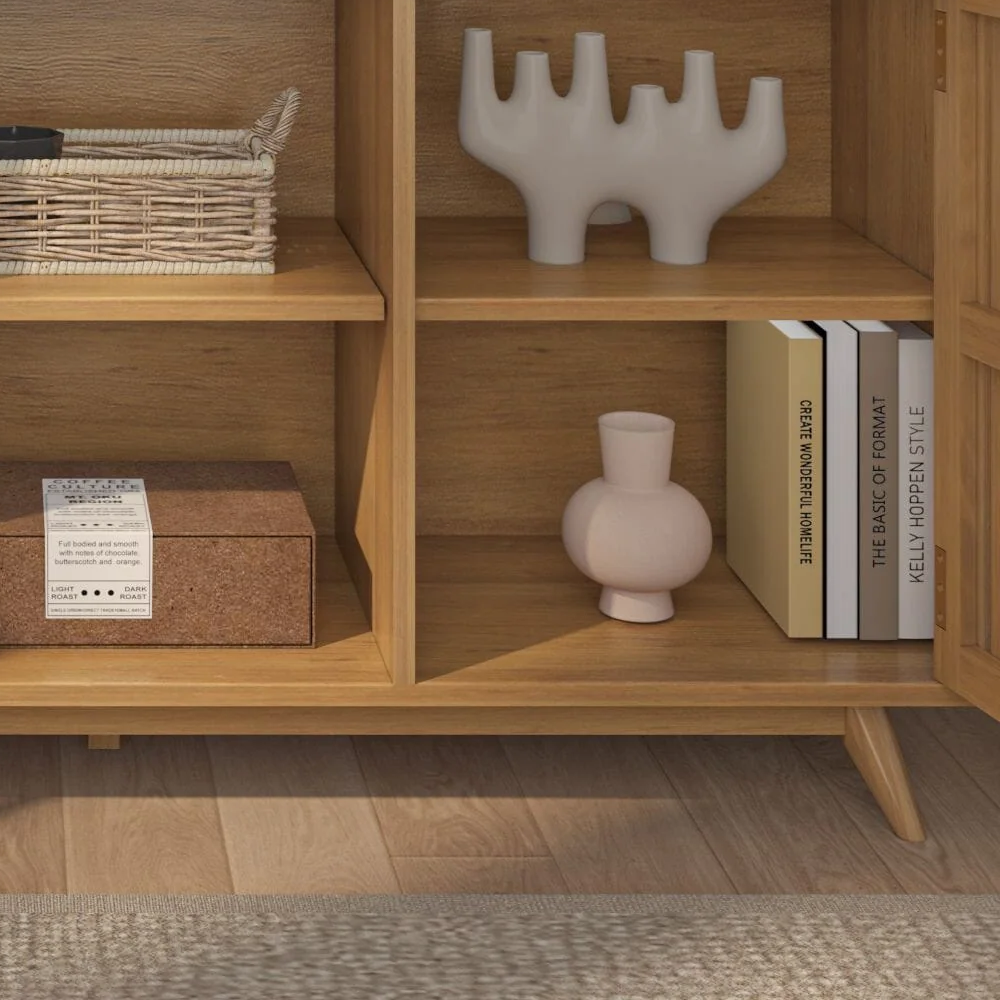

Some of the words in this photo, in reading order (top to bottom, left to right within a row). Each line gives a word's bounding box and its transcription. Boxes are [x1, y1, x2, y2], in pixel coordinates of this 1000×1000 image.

[800, 400, 812, 439] CREATE
[872, 396, 886, 459] FORMAT
[909, 406, 925, 455] STYLE
[800, 443, 812, 509] WONDERFUL
[872, 465, 886, 485] OF
[909, 461, 925, 527] HOPPEN
[872, 490, 886, 534] BASIC
[800, 511, 812, 564] HOMELIFE
[872, 538, 886, 568] THE
[909, 532, 925, 583] KELLY
